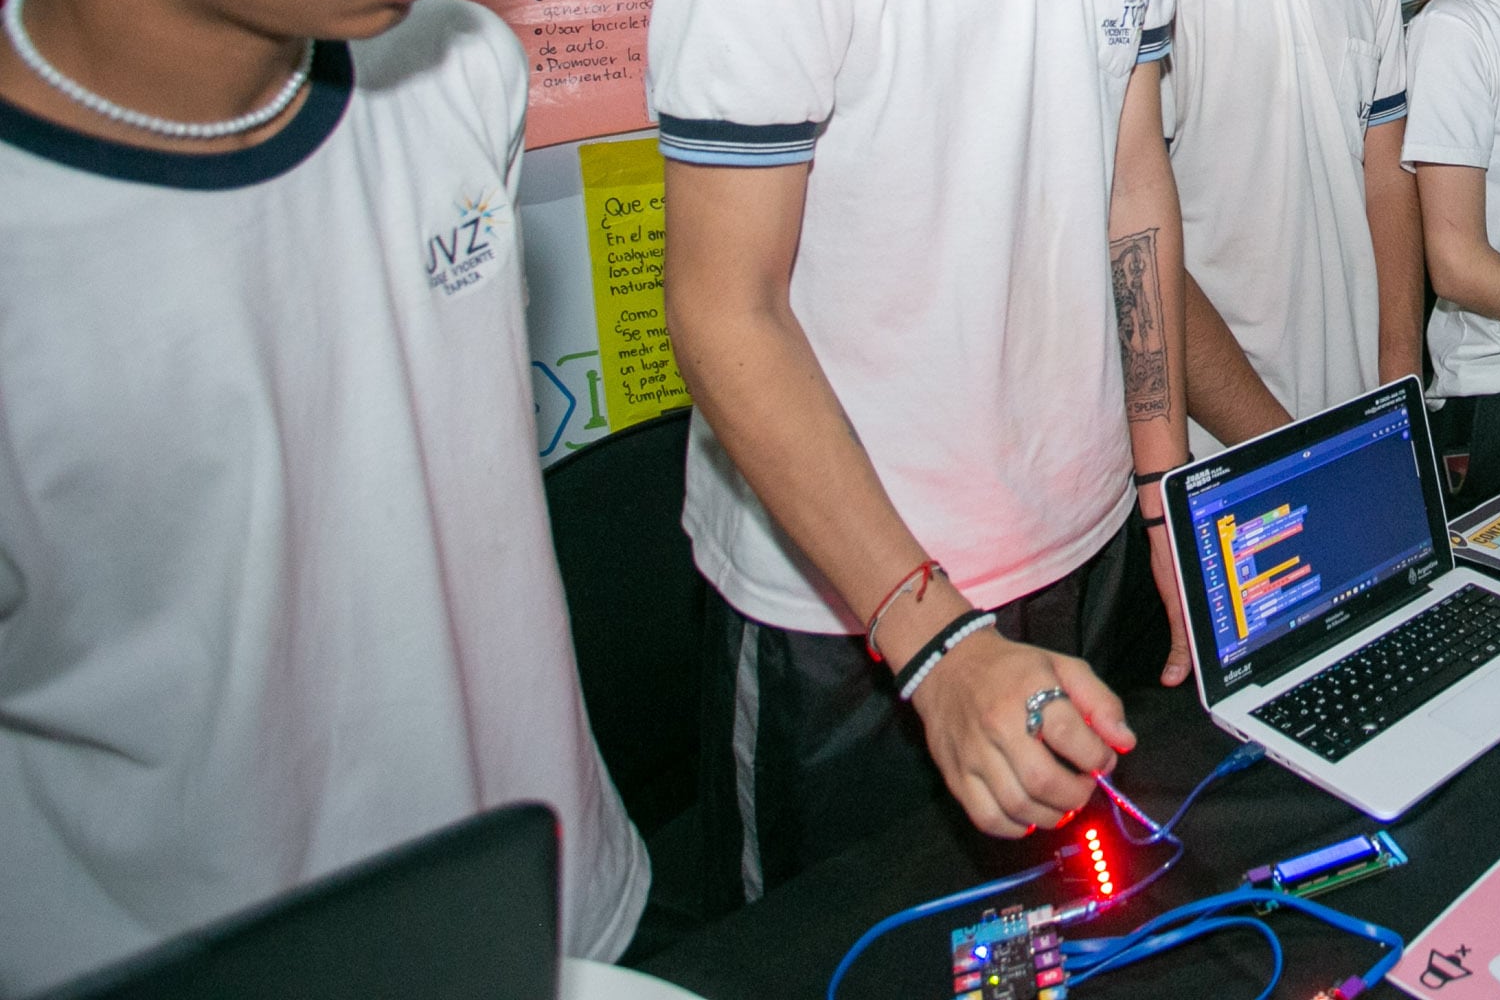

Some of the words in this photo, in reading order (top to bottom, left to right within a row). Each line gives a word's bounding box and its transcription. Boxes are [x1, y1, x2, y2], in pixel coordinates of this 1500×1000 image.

[545, 22, 584, 36] Usar
[539, 41, 557, 56] de
[548, 55, 618, 73] Promover
[628, 48, 641, 62] la
[606, 231, 626, 247] En
[630, 224, 642, 242] el
[424, 216, 489, 276] JVZ
[609, 265, 629, 278] los
[622, 327, 641, 342] Se
[618, 342, 654, 360] medir
[659, 338, 670, 352] el
[620, 365, 635, 376] un
[640, 358, 670, 374] lugar
[640, 373, 667, 390] para
